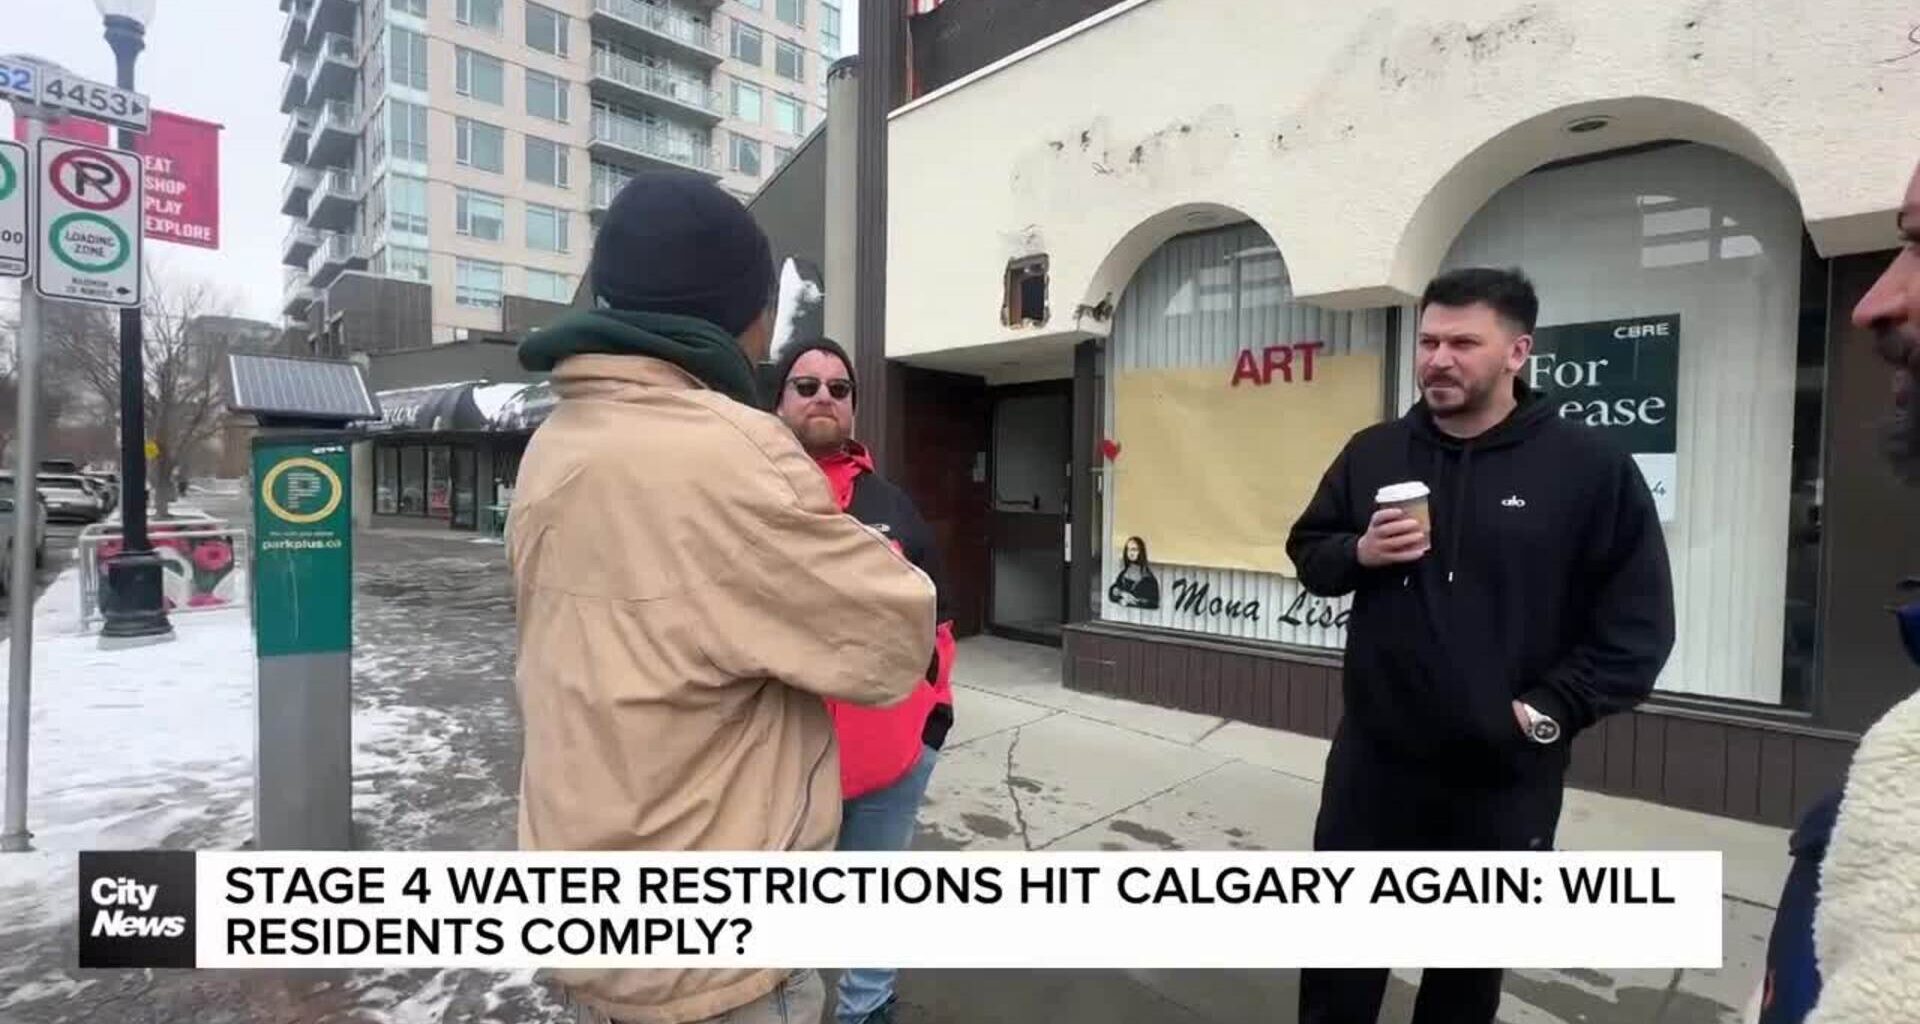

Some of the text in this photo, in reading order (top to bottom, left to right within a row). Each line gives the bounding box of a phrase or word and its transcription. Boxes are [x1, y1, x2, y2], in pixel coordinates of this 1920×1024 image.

[46, 79, 128, 117] 4453
[145, 155, 172, 173] EAT
[145, 176, 187, 194] SHOP
[145, 196, 182, 215] PLAY
[146, 216, 211, 240] EXPLORE
[64, 231, 115, 248] LOADING
[74, 243, 105, 258] ZONE
[1613, 323, 1670, 339] CBRE
[1231, 342, 1324, 387] ART
[1528, 353, 1609, 389] For
[1558, 396, 1666, 427] ease
[1501, 495, 1526, 507] alo
[262, 539, 342, 551] parkplus.ca
[1172, 578, 1261, 622] Mona
